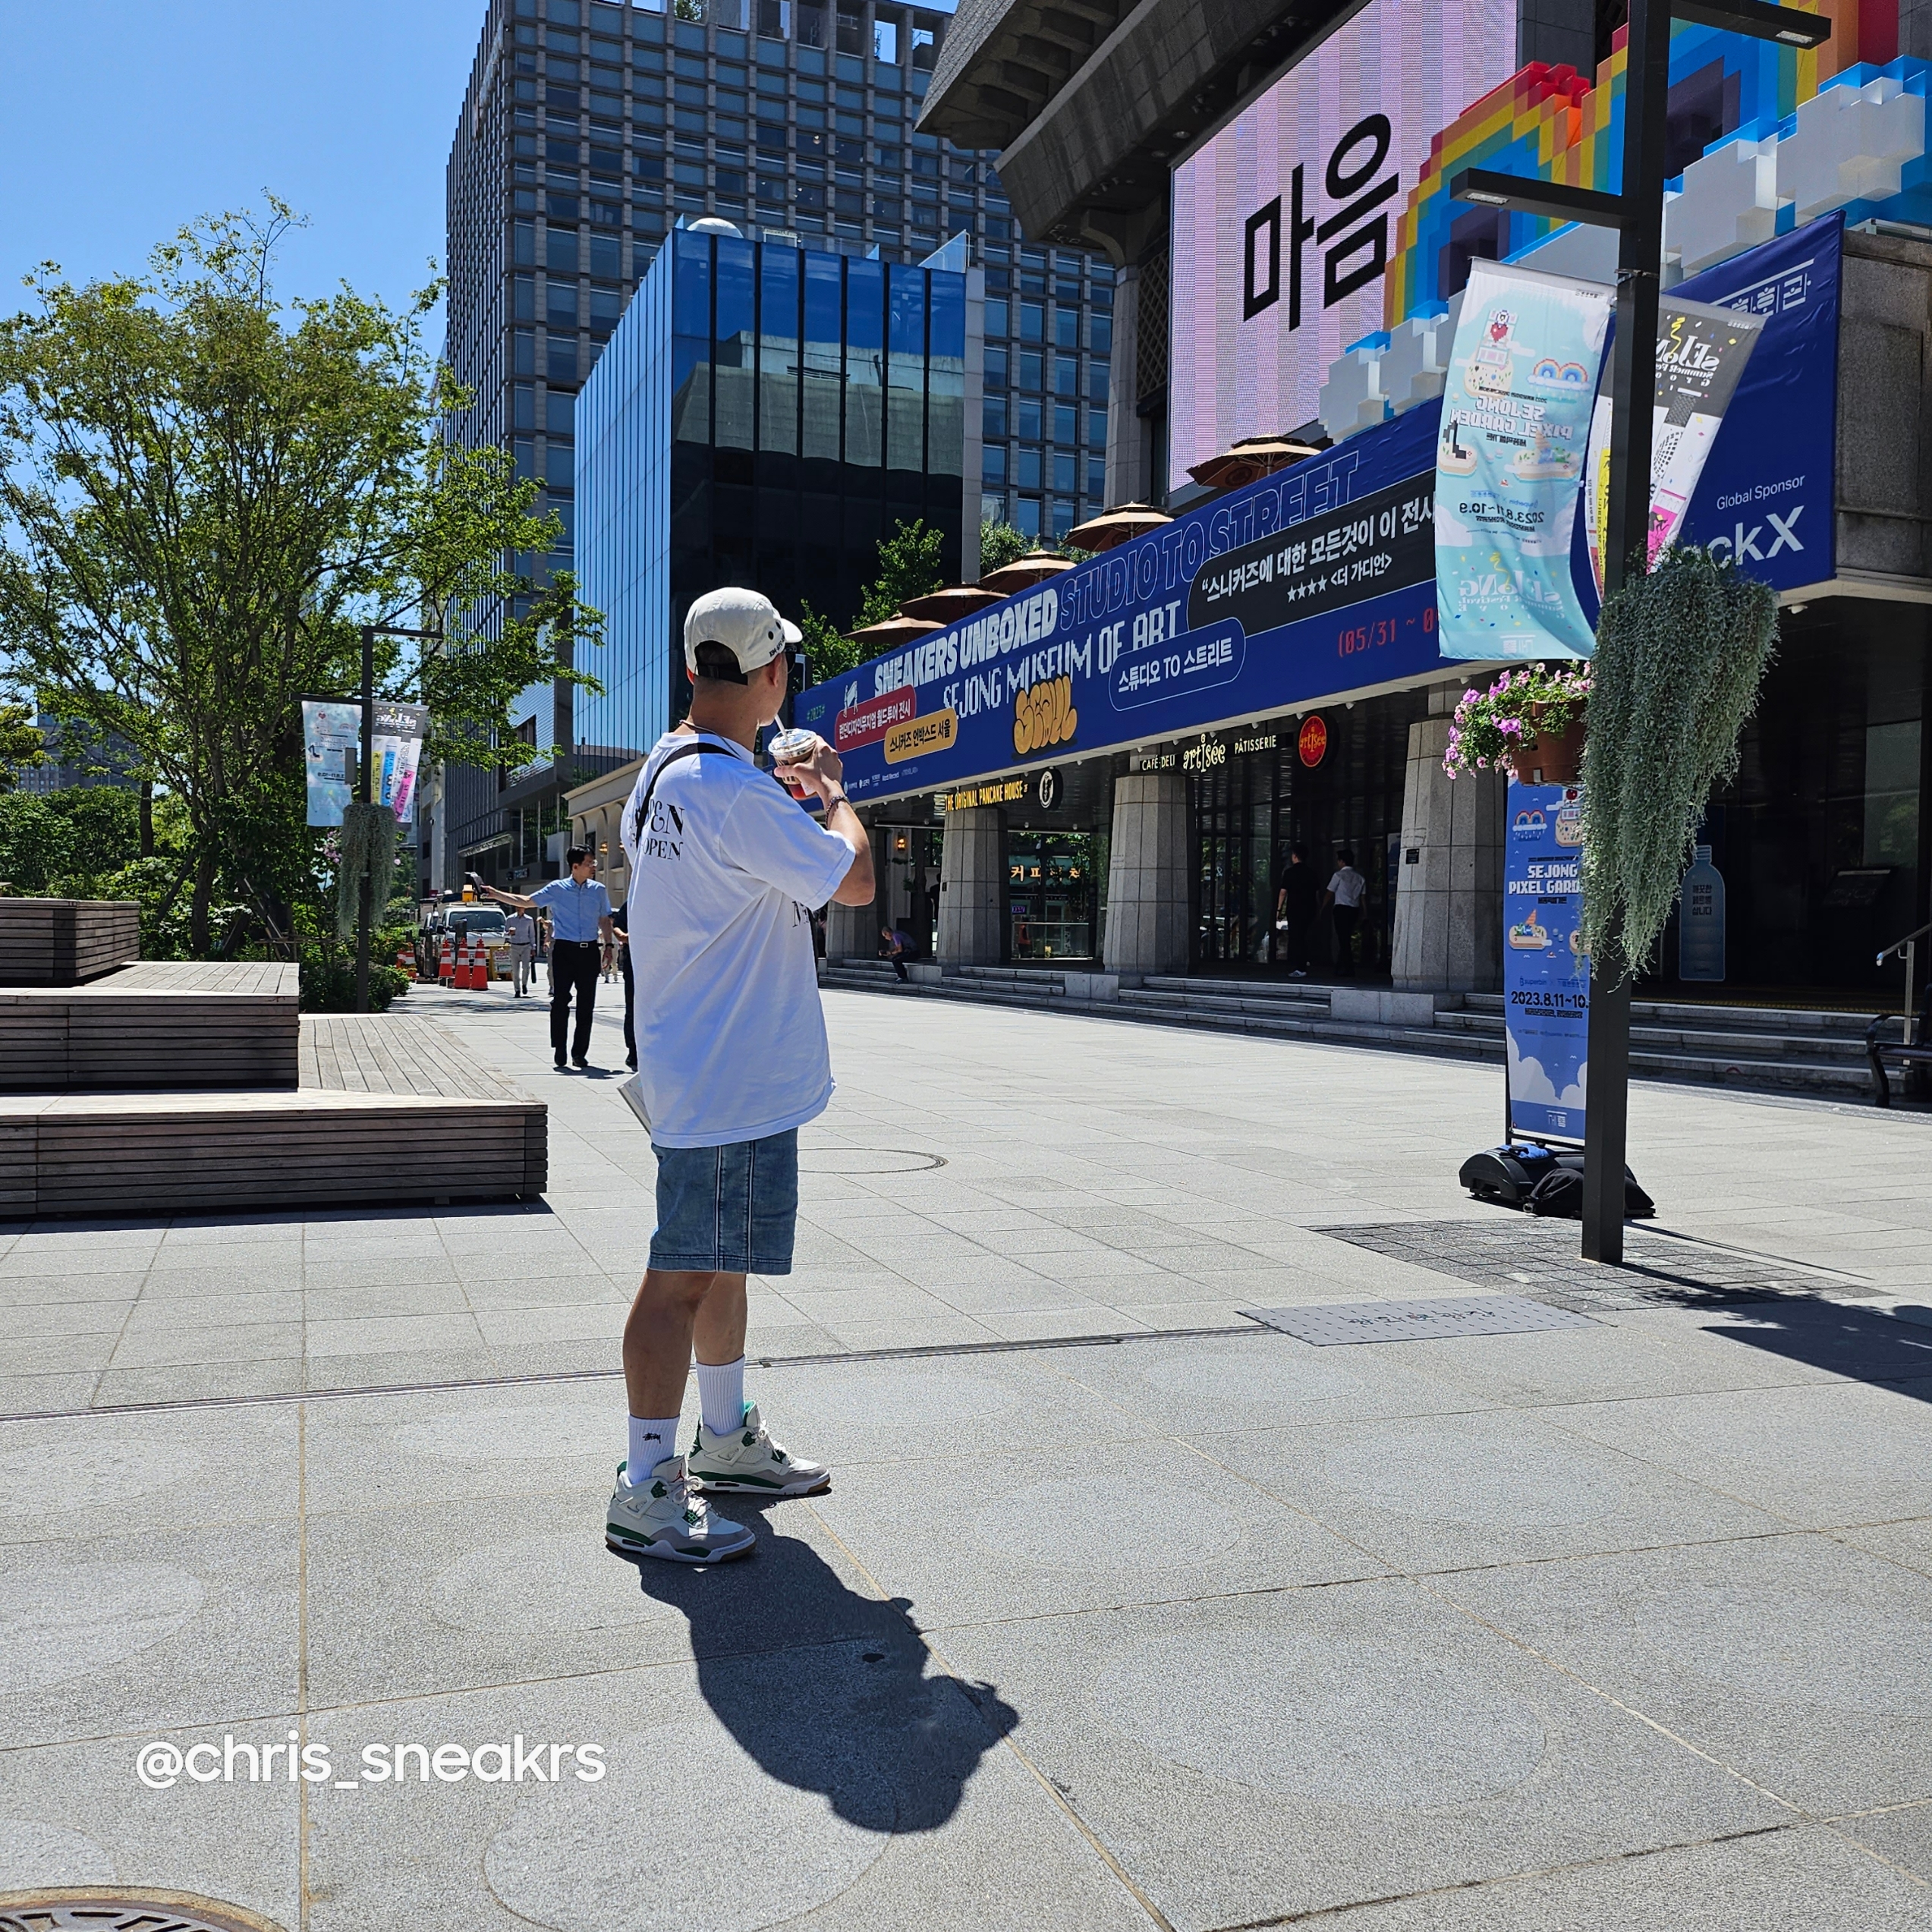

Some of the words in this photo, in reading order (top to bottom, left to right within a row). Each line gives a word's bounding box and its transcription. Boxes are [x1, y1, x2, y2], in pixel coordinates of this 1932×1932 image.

[1243, 113, 1399, 332] 마음
[1716, 489, 1751, 510] Global
[1754, 475, 1805, 500] Sponsor
[1277, 542, 1307, 574] 대한
[1311, 519, 1374, 565] 모든것이
[1379, 514, 1396, 539] 이
[874, 637, 957, 697] SNEAKERS
[960, 589, 1058, 669] UNBOXED
[1060, 542, 1160, 631] STUDIO
[1162, 523, 1204, 589] TO
[1209, 451, 1359, 559] STREET
[1338, 618, 1396, 658] (05/31
[1423, 608, 1439, 633] 0
[943, 668, 1001, 719] SEJONG
[1007, 638, 1091, 704] MUSEUM
[1098, 621, 1126, 674] OF
[1134, 600, 1182, 650] ART
[1118, 660, 1162, 693] 스튜디오
[1163, 658, 1180, 678] TO
[1183, 637, 1233, 674] 스트리트
[839, 711, 876, 740] 런던디자인뮤지엄
[876, 705, 898, 728] 월드투어
[898, 698, 911, 721] 전시
[889, 732, 912, 753] 스니커즈
[913, 723, 936, 747] 언박스드
[937, 718, 951, 740] 서울
[1235, 735, 1277, 754] PÂTISSERIE
[945, 795, 954, 811] THE
[955, 789, 978, 810] ORIGINAL
[979, 784, 1003, 805] PANCAKE
[1004, 780, 1023, 801] HOUSE
[1509, 881, 1544, 895] PIXEL
[1528, 864, 1578, 879] SEJONG
